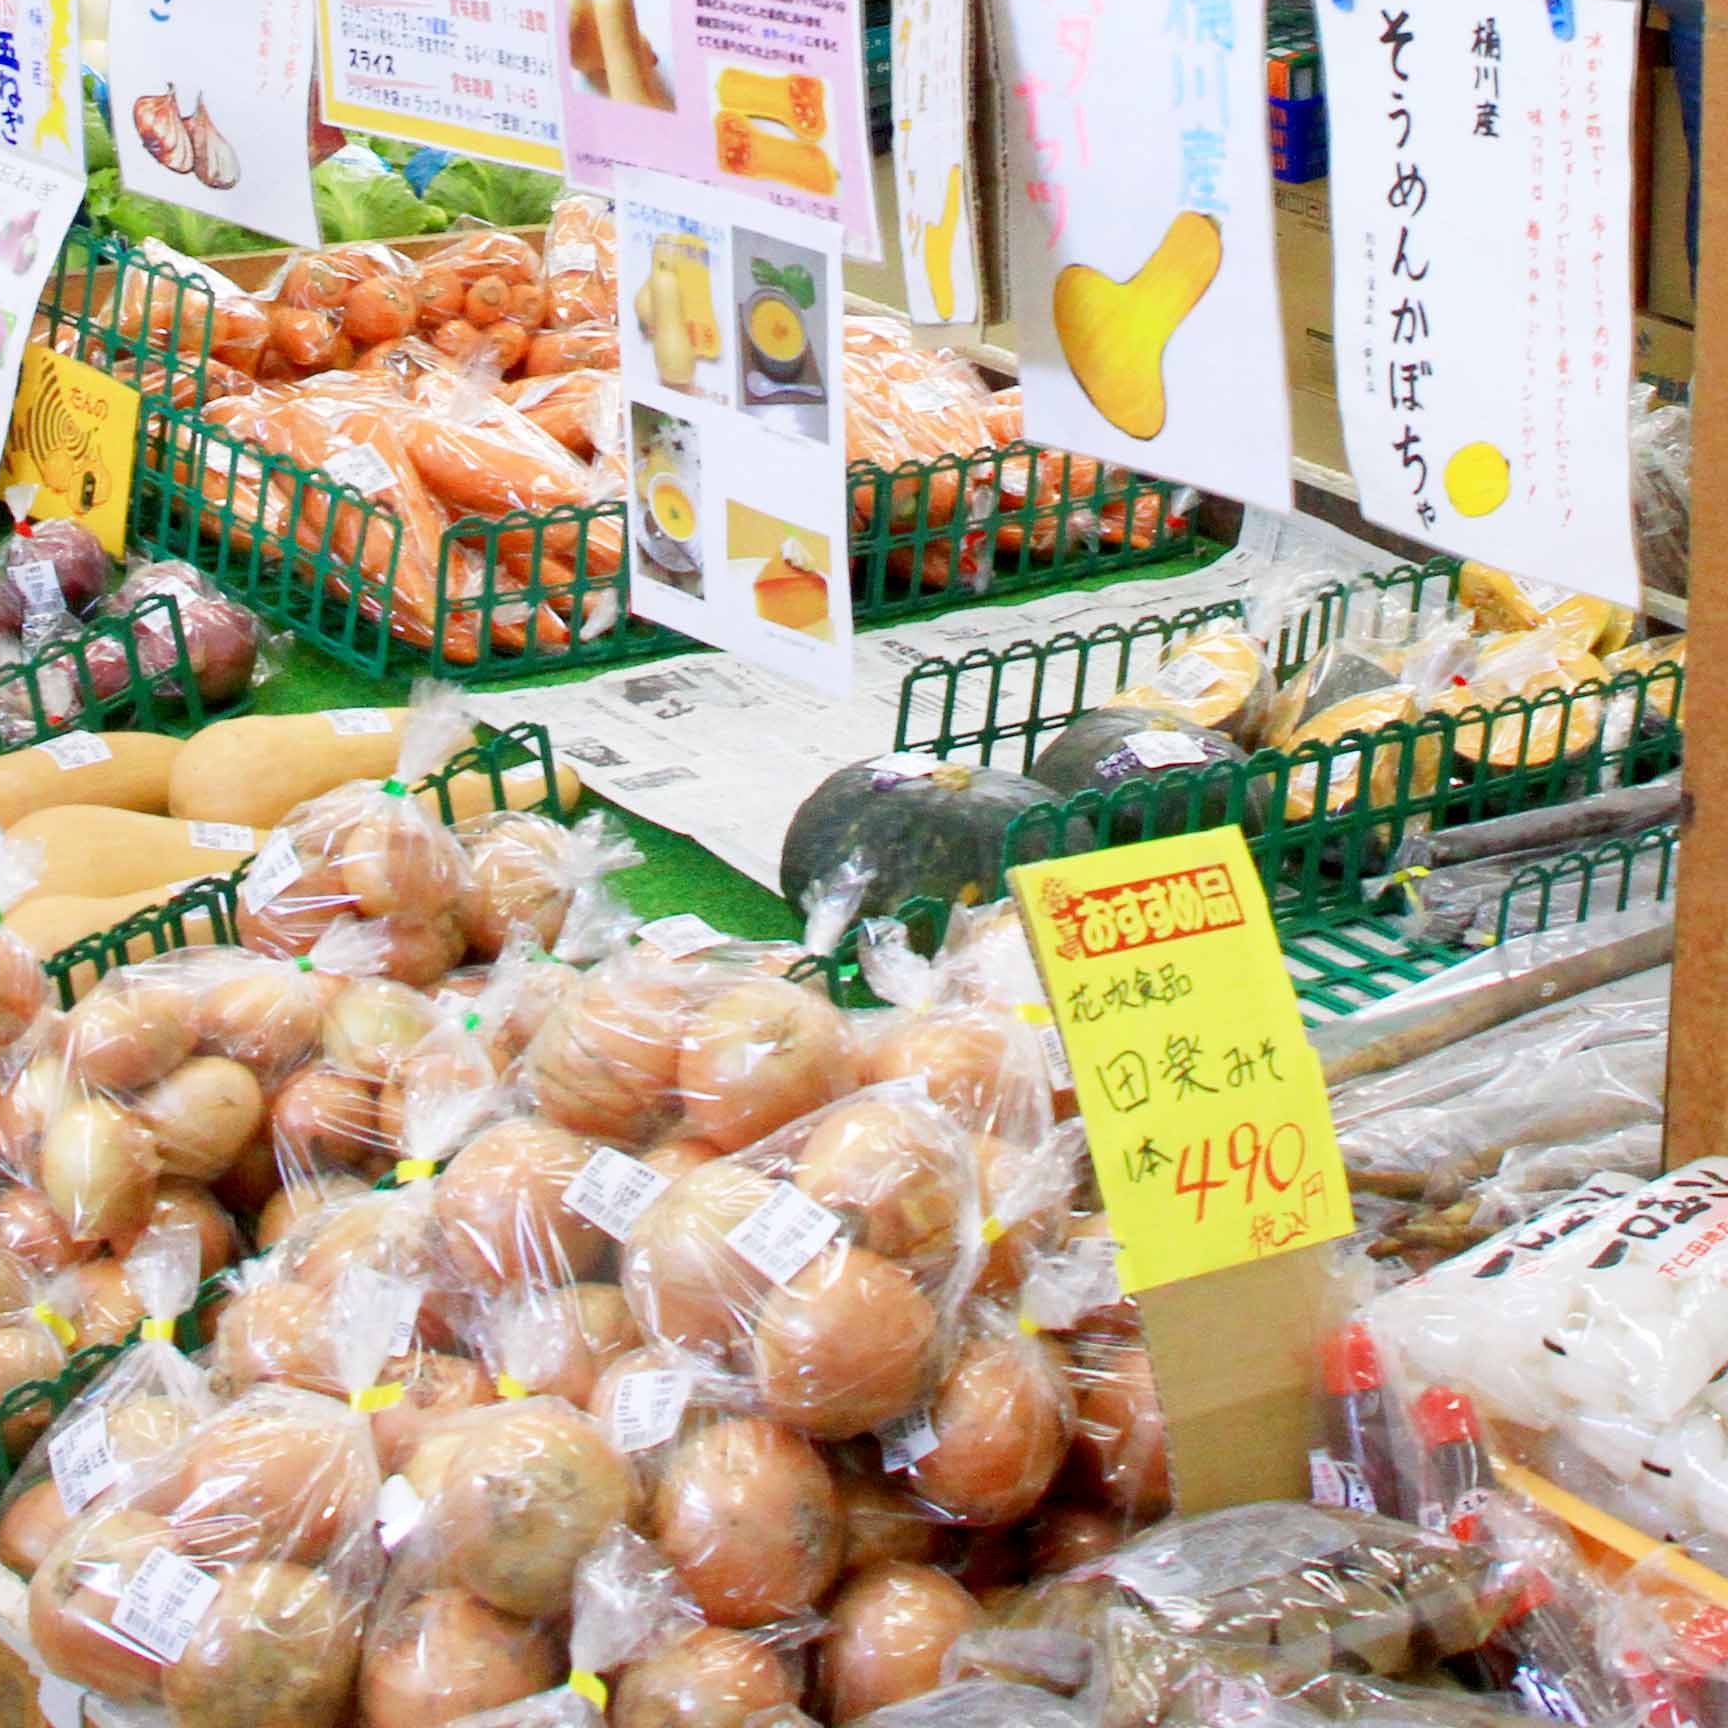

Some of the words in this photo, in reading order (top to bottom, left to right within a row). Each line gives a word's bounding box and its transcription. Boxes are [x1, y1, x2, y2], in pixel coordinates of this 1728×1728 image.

[347, 48, 396, 76] スライス
[1471, 16, 1502, 139] 桶川産
[1379, 8, 1436, 531] そうめんかぼちゃ
[1075, 867, 1234, 954] おすすめ品
[1095, 1034, 1284, 1114] 田楽みそ
[1247, 1211, 1308, 1255] 税込
